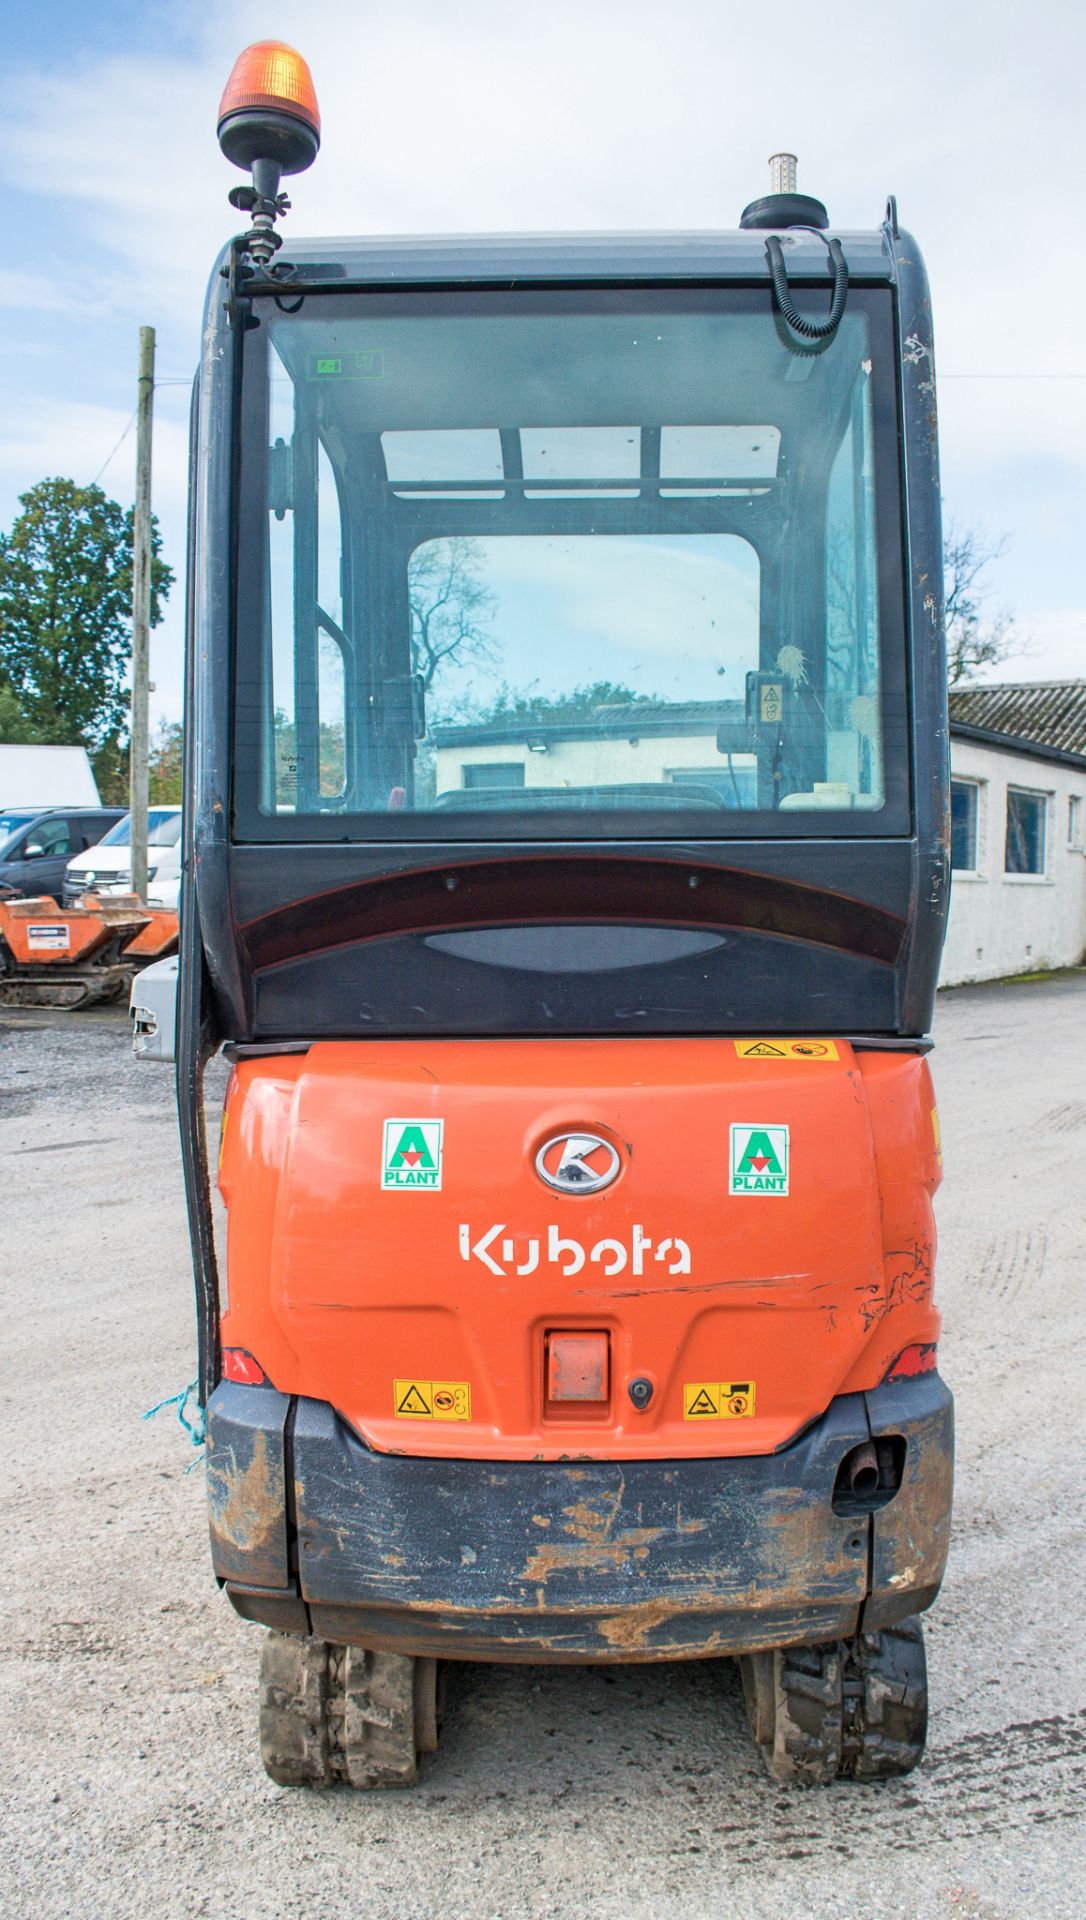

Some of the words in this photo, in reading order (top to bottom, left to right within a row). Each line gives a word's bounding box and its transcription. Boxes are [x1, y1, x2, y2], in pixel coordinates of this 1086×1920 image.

[388, 1126, 435, 1168] A
[736, 1131, 783, 1174] A
[384, 1171, 439, 1185] PLANT
[732, 1176, 787, 1190] PLANT
[458, 1223, 692, 1276] Kubota
